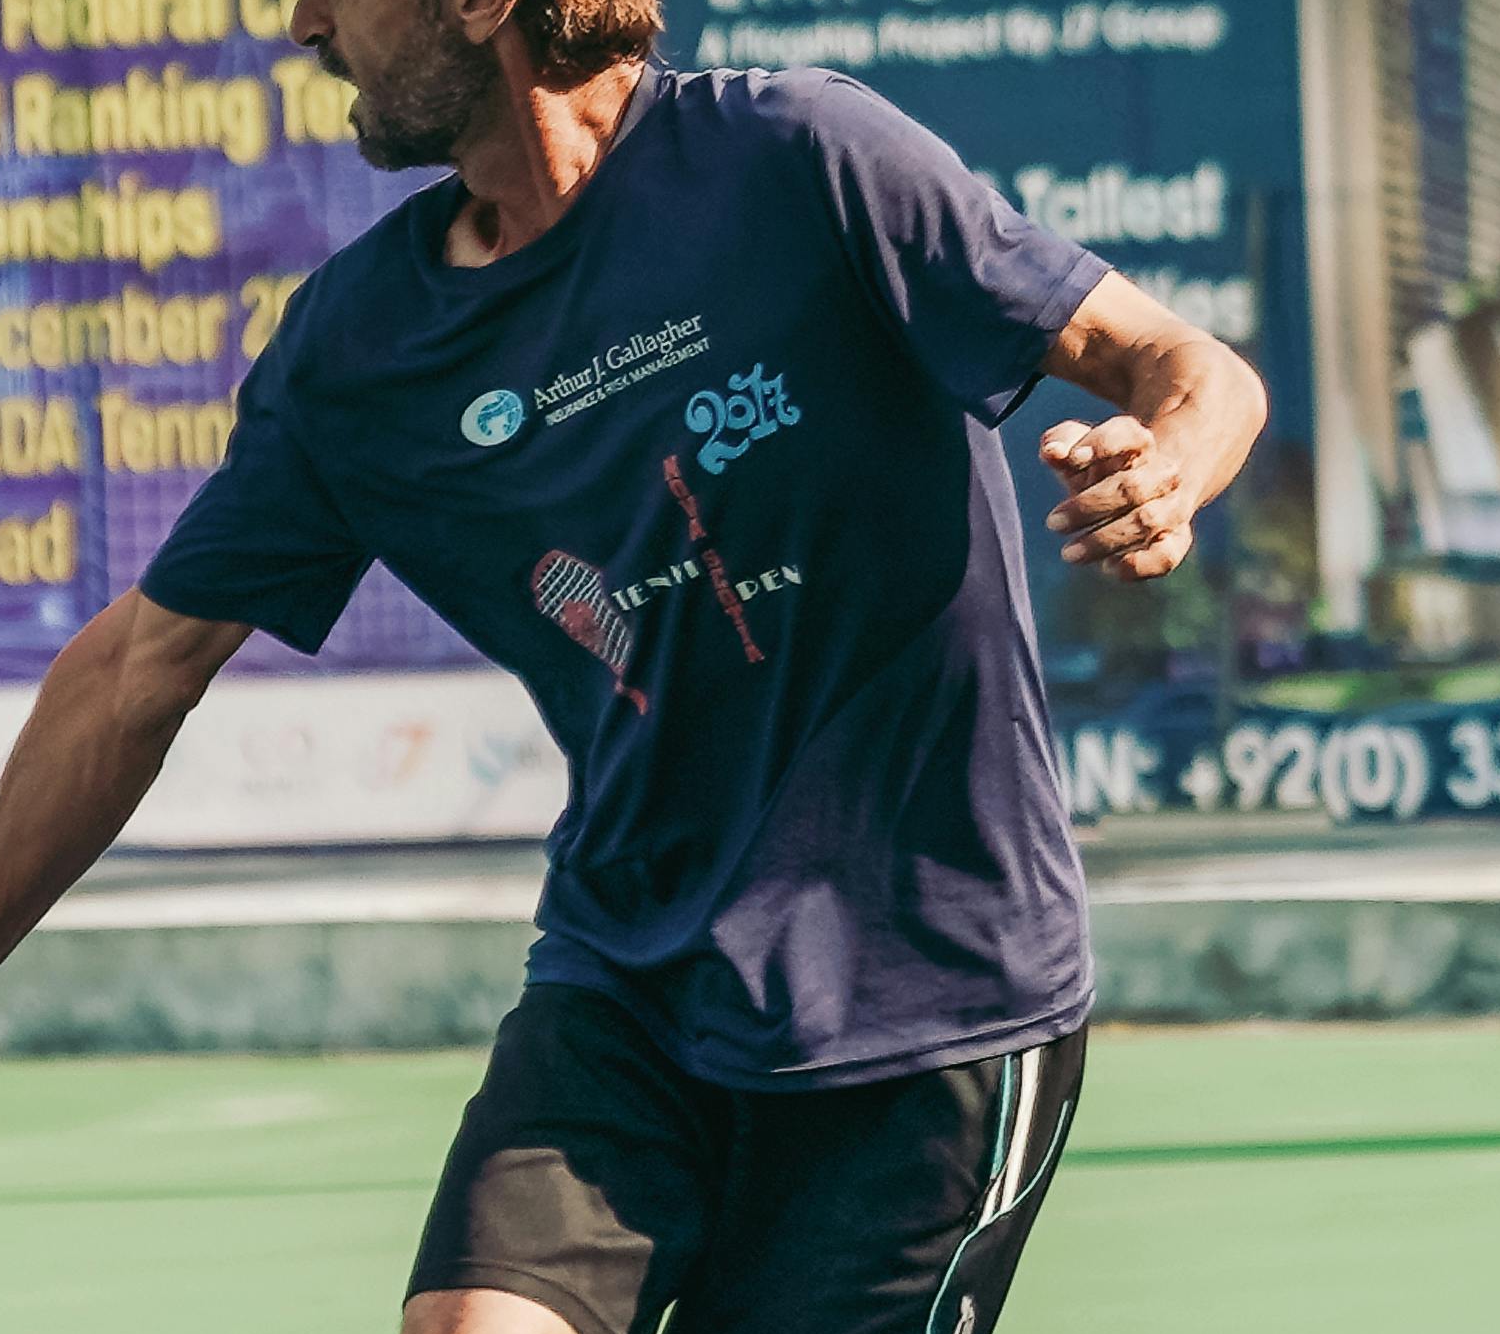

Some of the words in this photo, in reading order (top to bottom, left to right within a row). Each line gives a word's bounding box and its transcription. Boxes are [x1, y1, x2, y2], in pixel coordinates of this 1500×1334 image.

[9, 62, 269, 166] Ranking
[534, 367, 592, 410] Arthur
[605, 315, 702, 369] Gallagher
